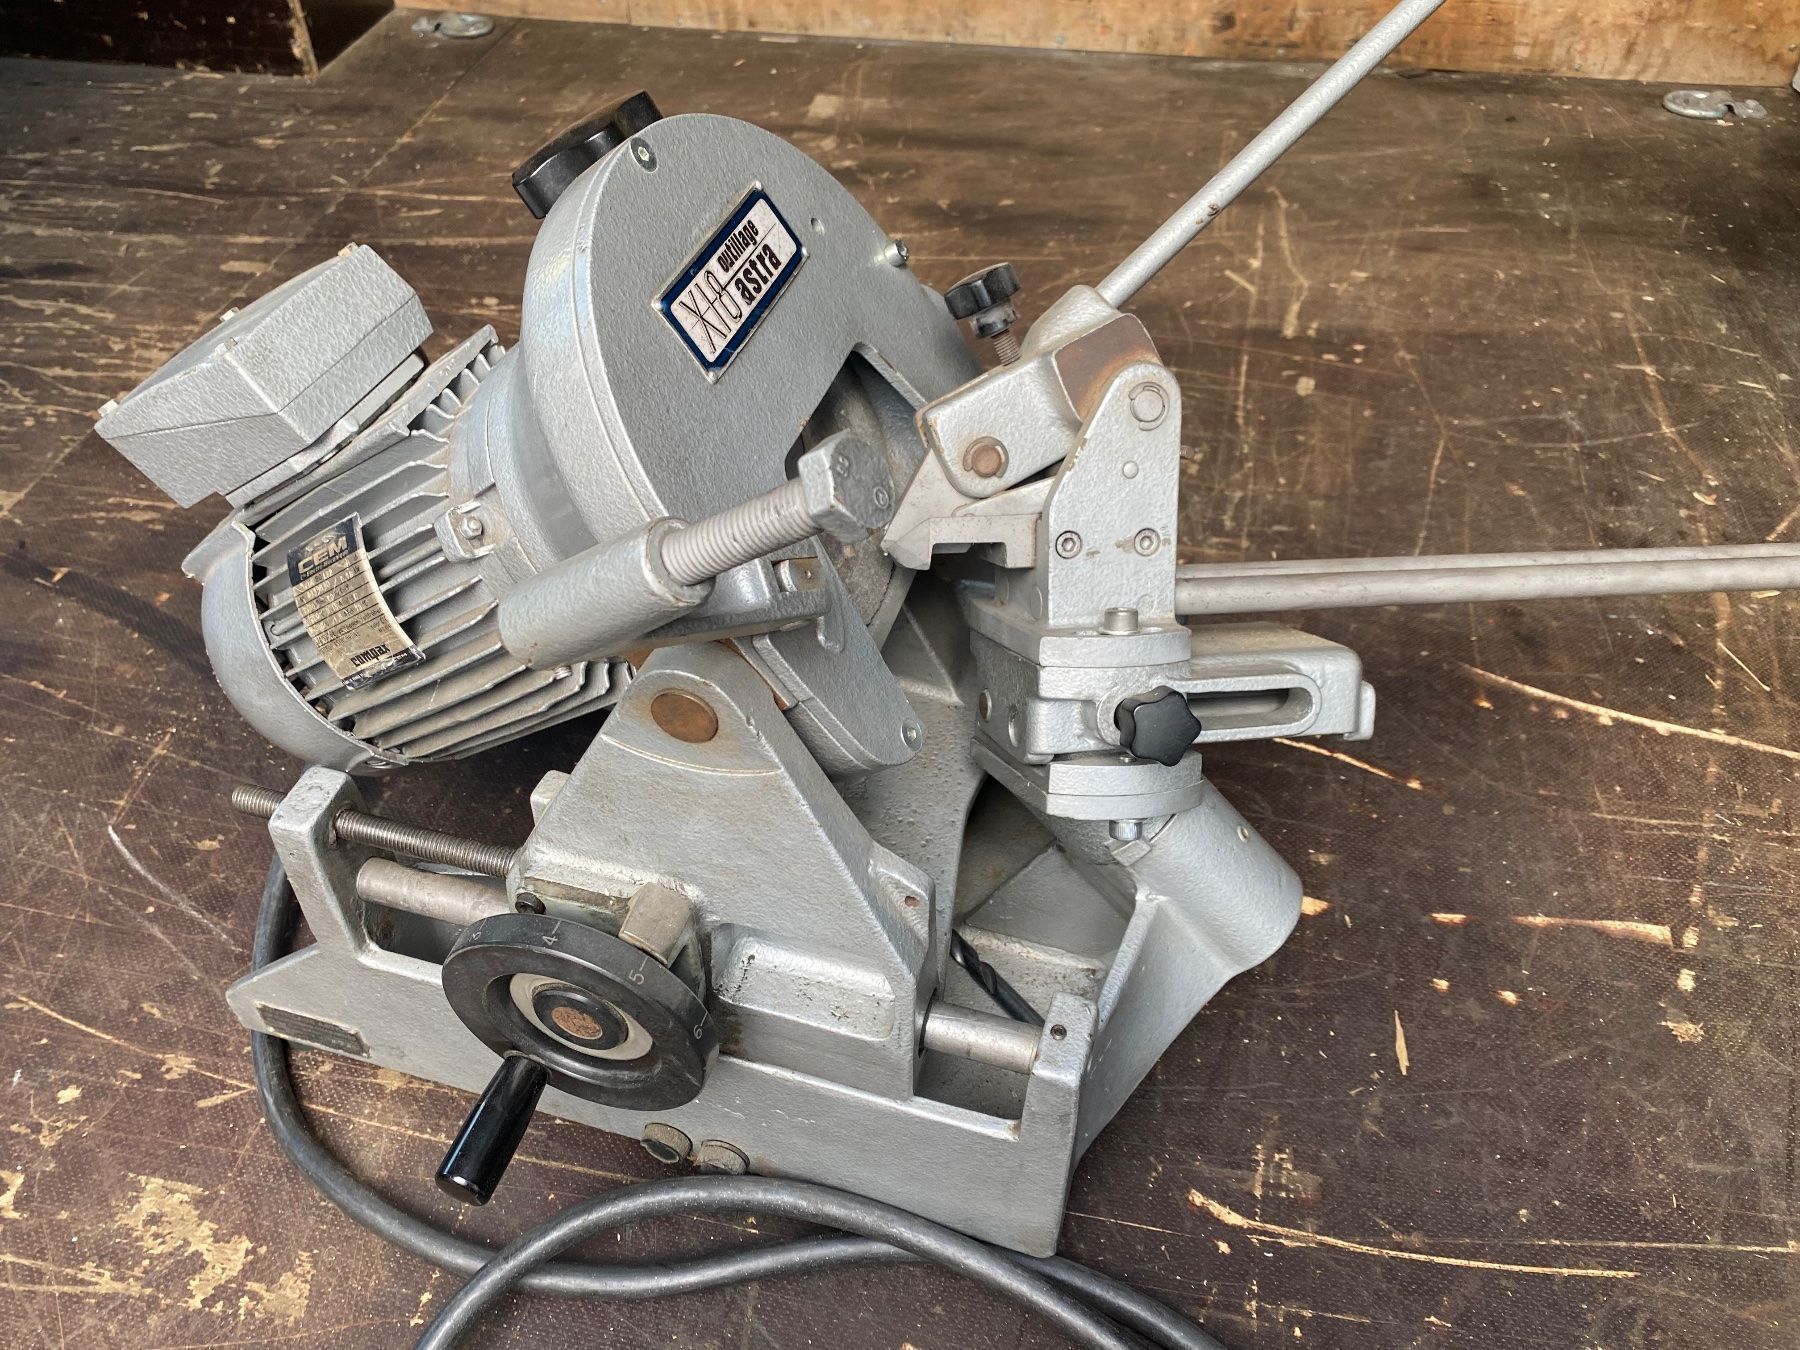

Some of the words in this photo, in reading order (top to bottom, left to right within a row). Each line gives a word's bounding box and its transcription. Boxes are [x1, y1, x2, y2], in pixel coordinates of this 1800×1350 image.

[717, 219, 759, 272] outillage
[735, 243, 782, 306] astra
[297, 536, 349, 574] CEM
[351, 643, 391, 667] compax
[541, 935, 559, 946] 4
[628, 968, 645, 985] 5
[693, 1023, 704, 1039] 6
